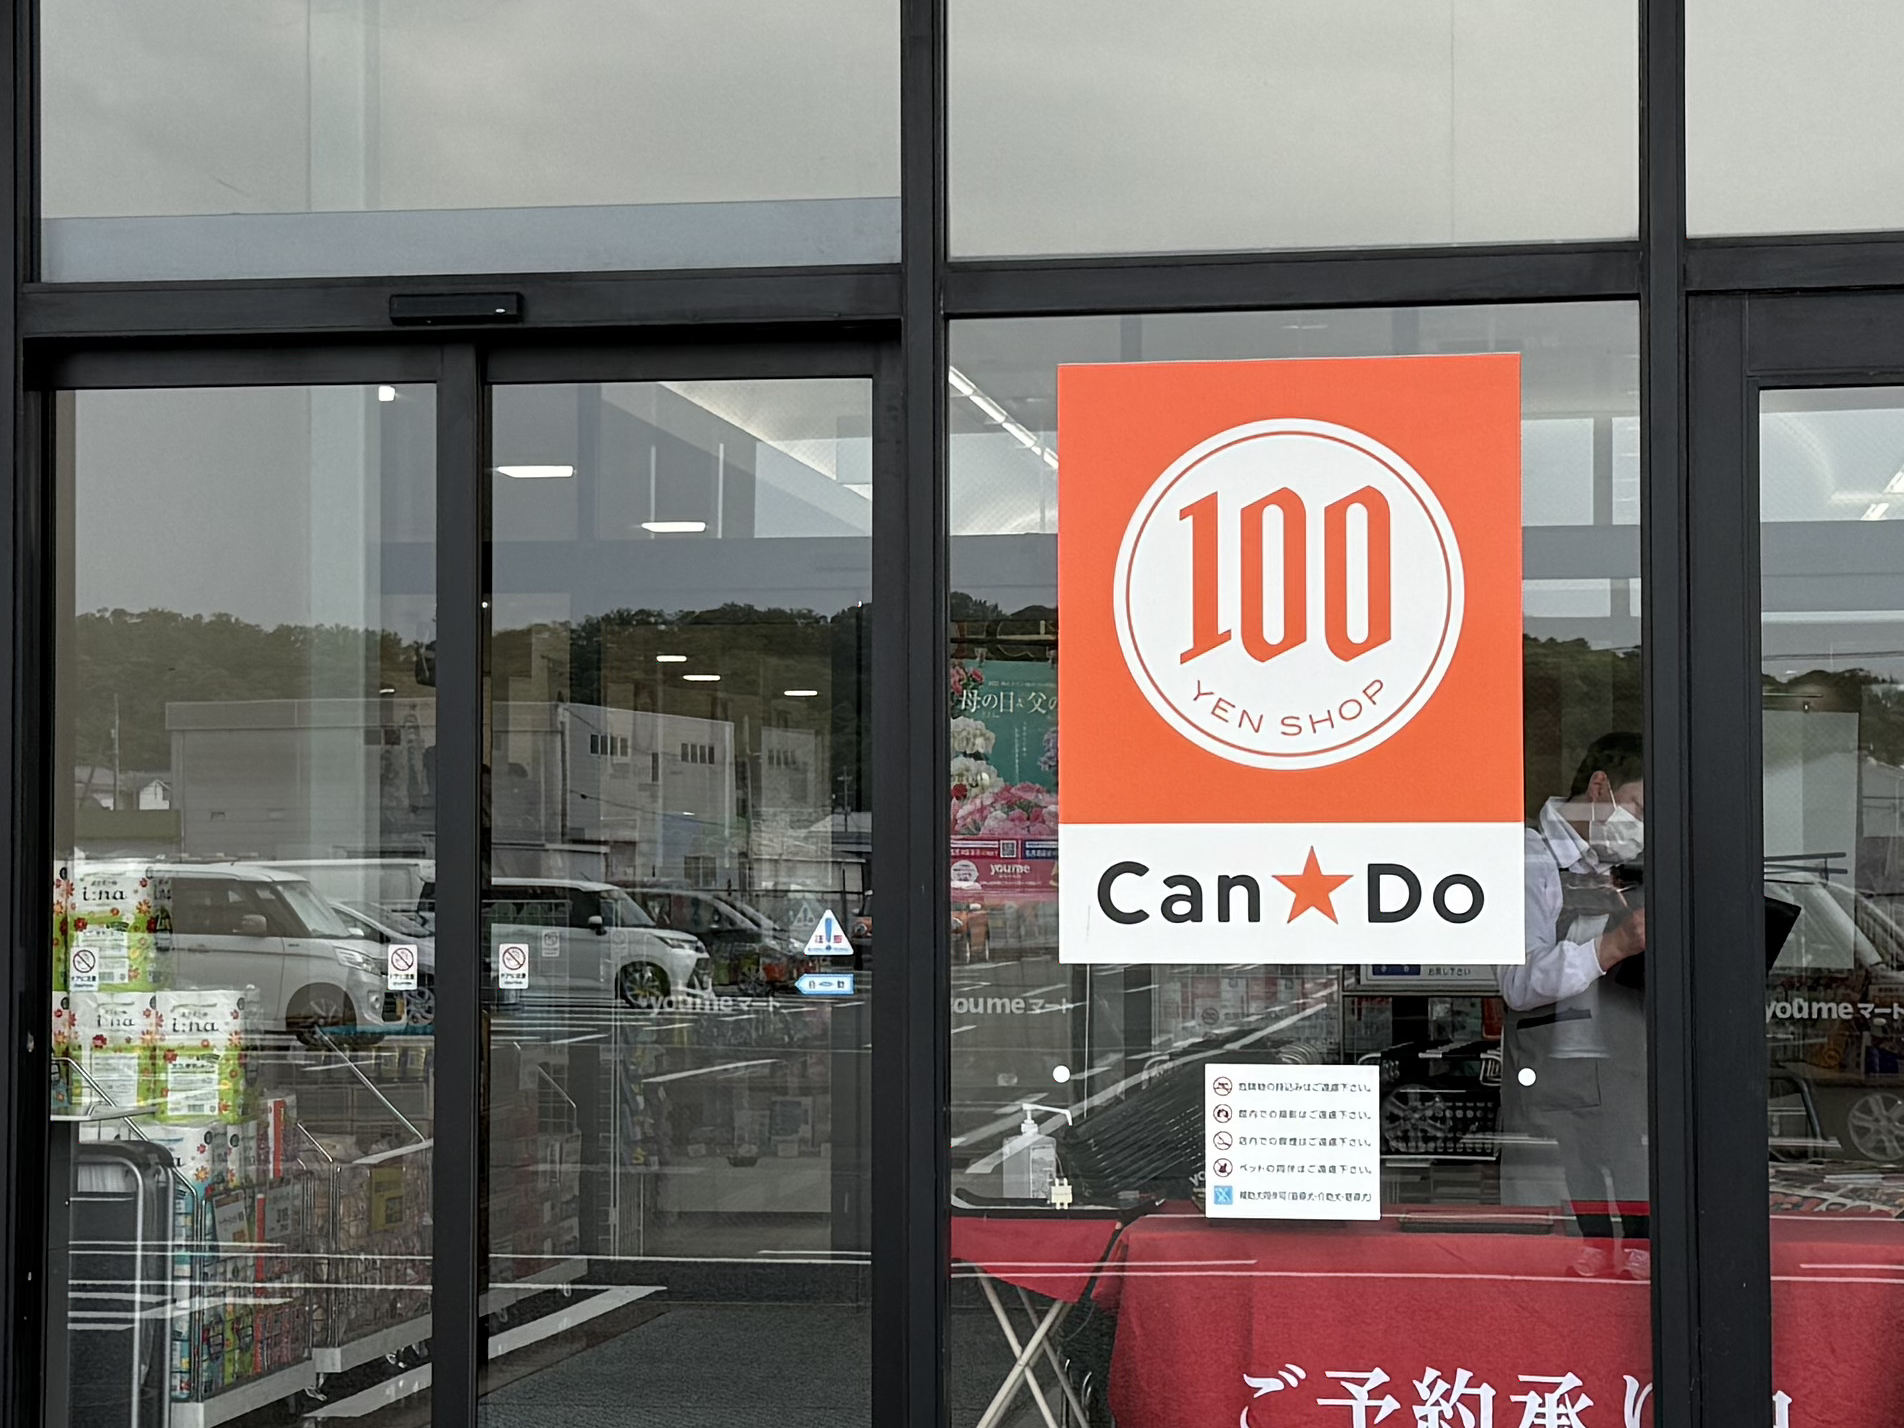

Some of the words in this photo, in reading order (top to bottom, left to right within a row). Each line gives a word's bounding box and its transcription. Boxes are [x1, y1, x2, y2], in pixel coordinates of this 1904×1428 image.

[1179, 485, 1392, 665] 100
[1192, 679, 1263, 734] YEN
[1280, 679, 1386, 736] SHOP
[1097, 861, 1262, 925] Can
[1367, 863, 1486, 925] Do
